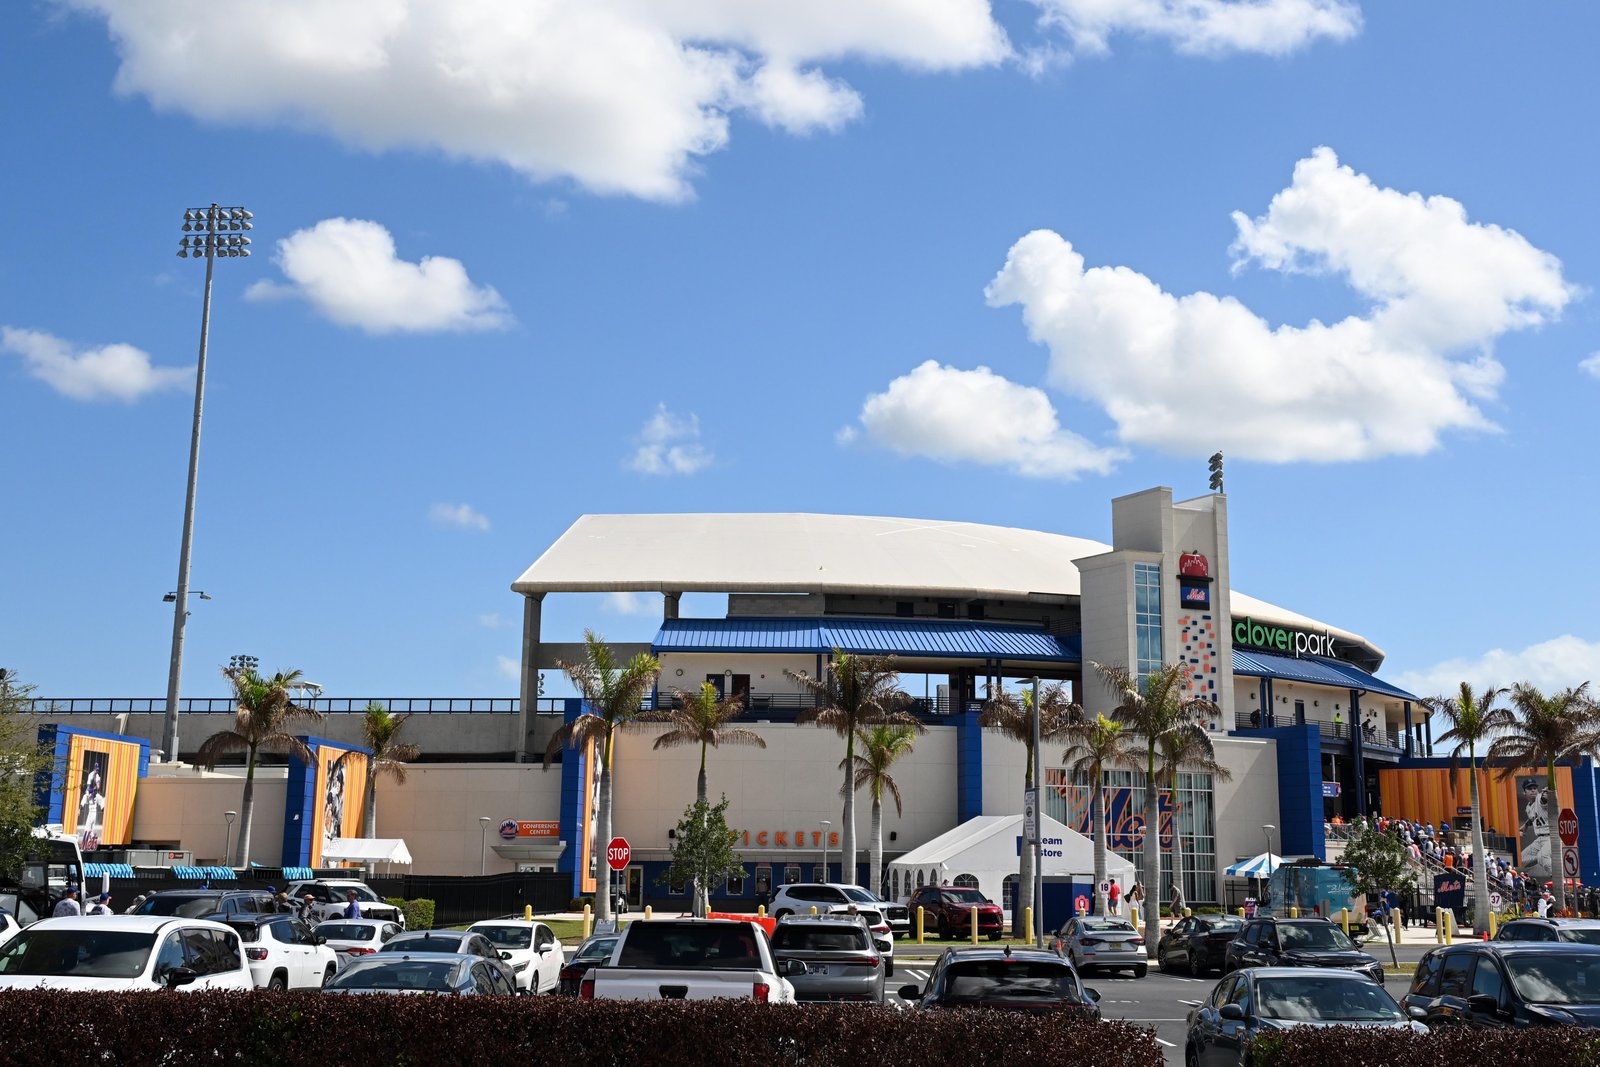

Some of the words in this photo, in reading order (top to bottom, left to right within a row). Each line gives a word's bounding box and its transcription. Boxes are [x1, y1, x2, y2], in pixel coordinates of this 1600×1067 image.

[1235, 616, 1293, 650] clover
[1295, 629, 1336, 658] park
[1560, 820, 1577, 834] STOP
[608, 848, 629, 860] STOP
[1100, 883, 1108, 891] 18
[1438, 881, 1461, 893] Mets
[1490, 895, 1500, 904] 37
